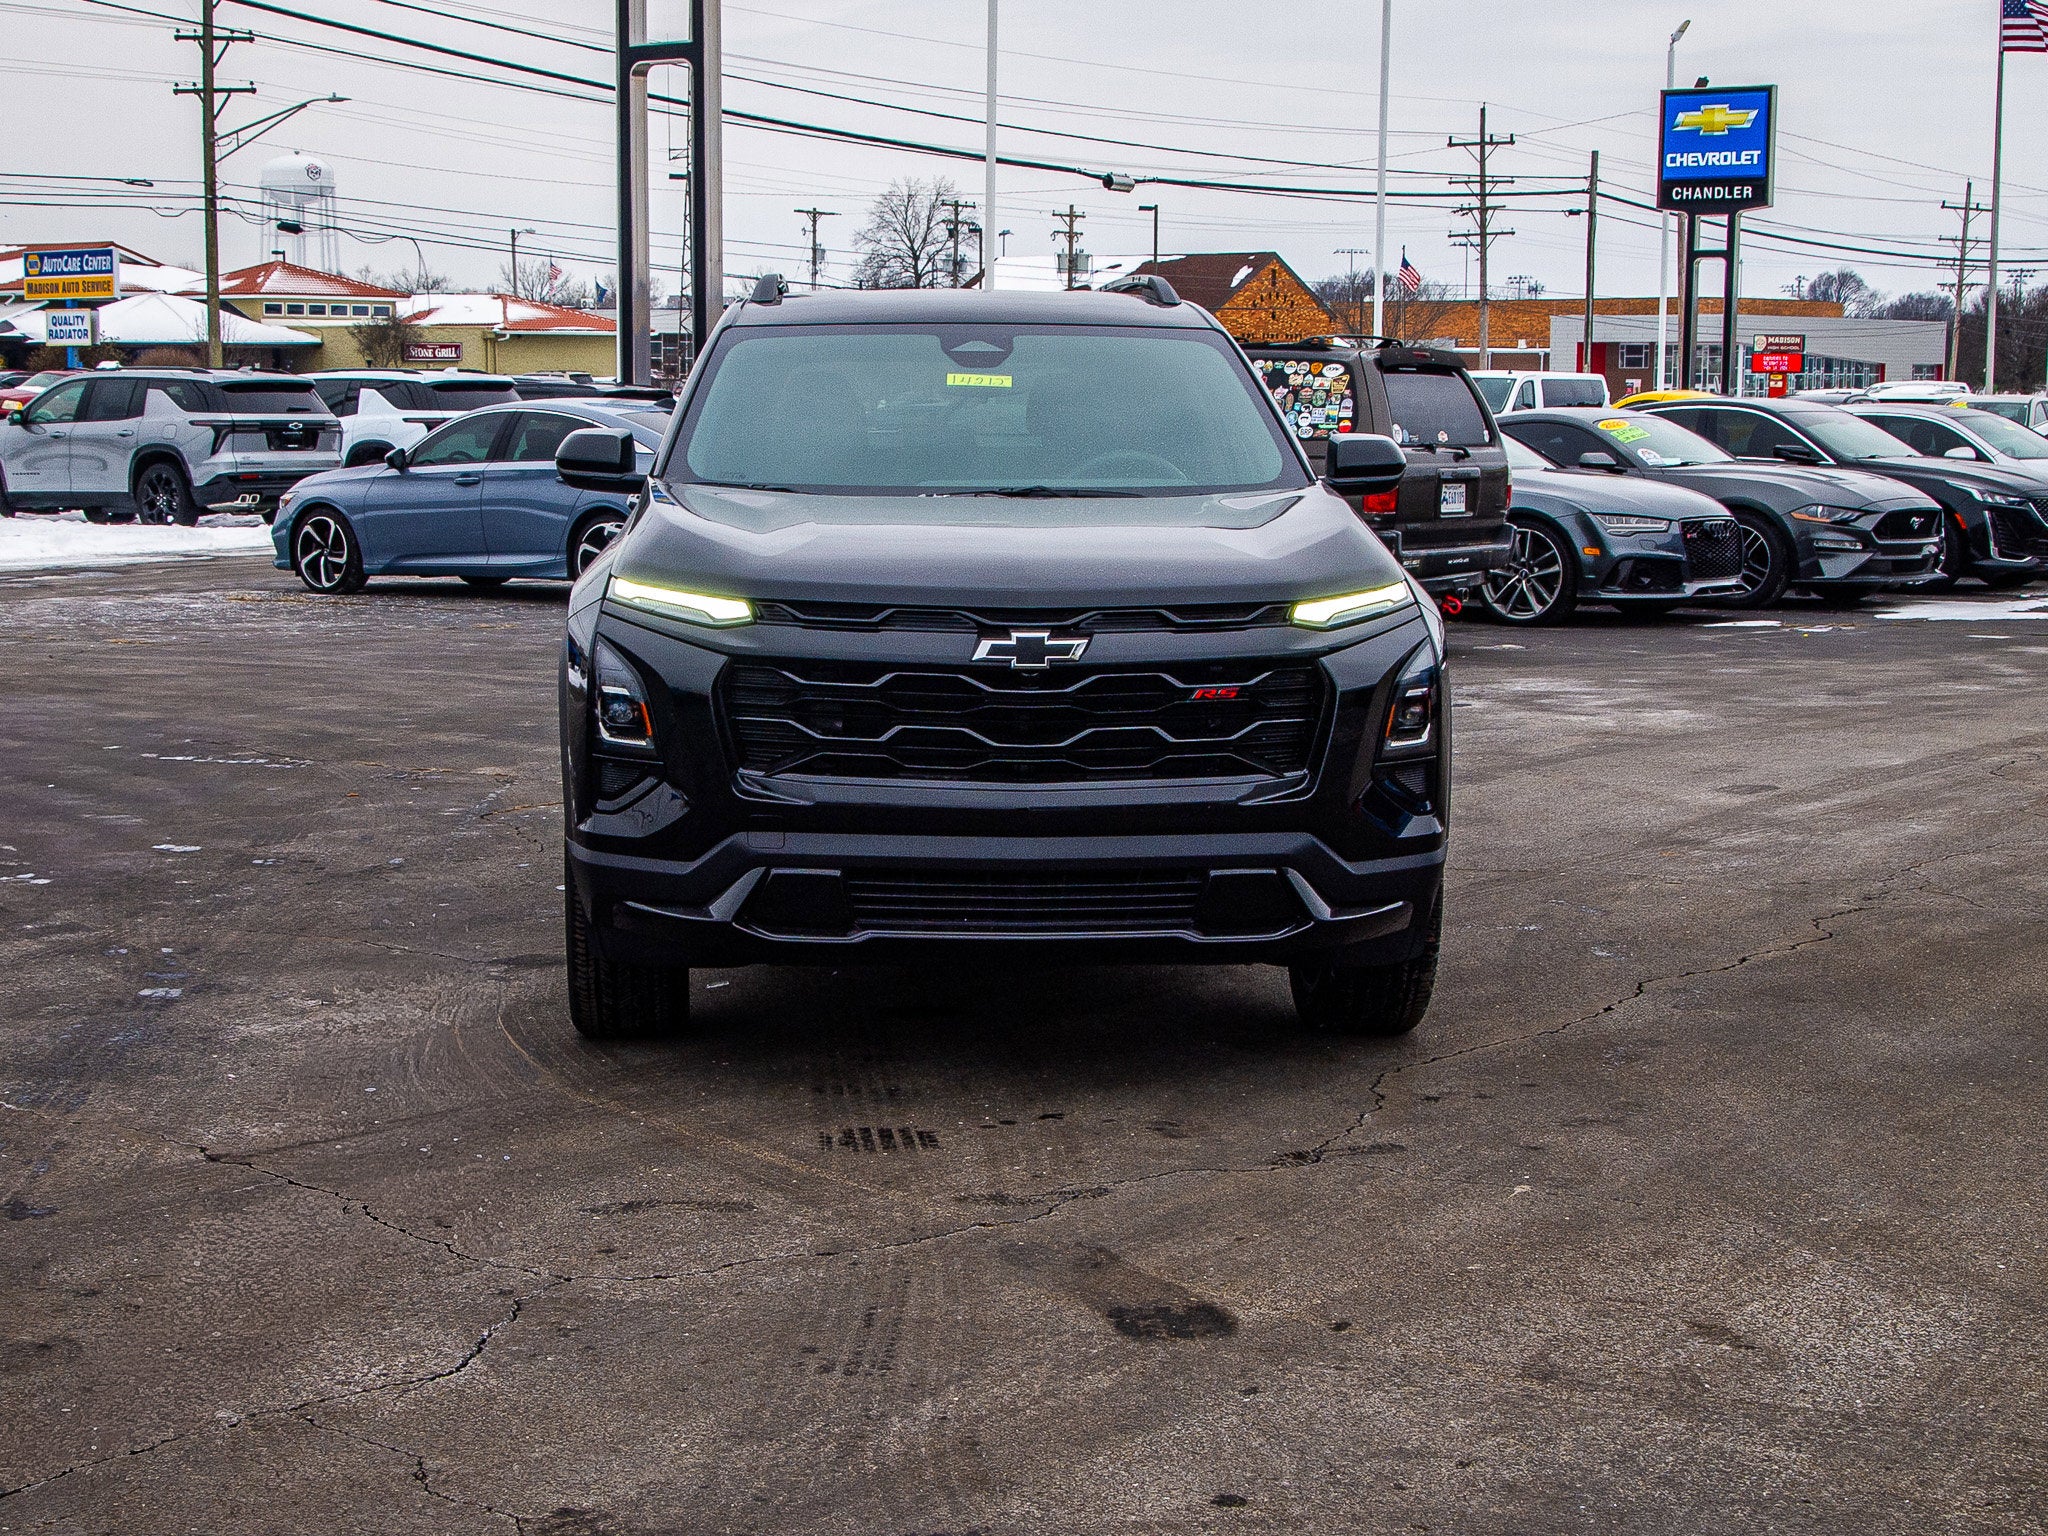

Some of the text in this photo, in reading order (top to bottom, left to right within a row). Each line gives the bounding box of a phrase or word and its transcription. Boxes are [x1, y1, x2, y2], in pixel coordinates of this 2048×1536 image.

[1666, 150, 1761, 167] CHEVROLET
[1672, 186, 1752, 200] CHANDLER
[83, 254, 111, 271] CENTER
[27, 280, 111, 294] MADISON AUTO SERVICE
[51, 315, 85, 326] QUALITY
[48, 329, 88, 339] RADIATOR
[410, 347, 457, 357] STONE GRILL
[1192, 687, 1240, 699] RS
